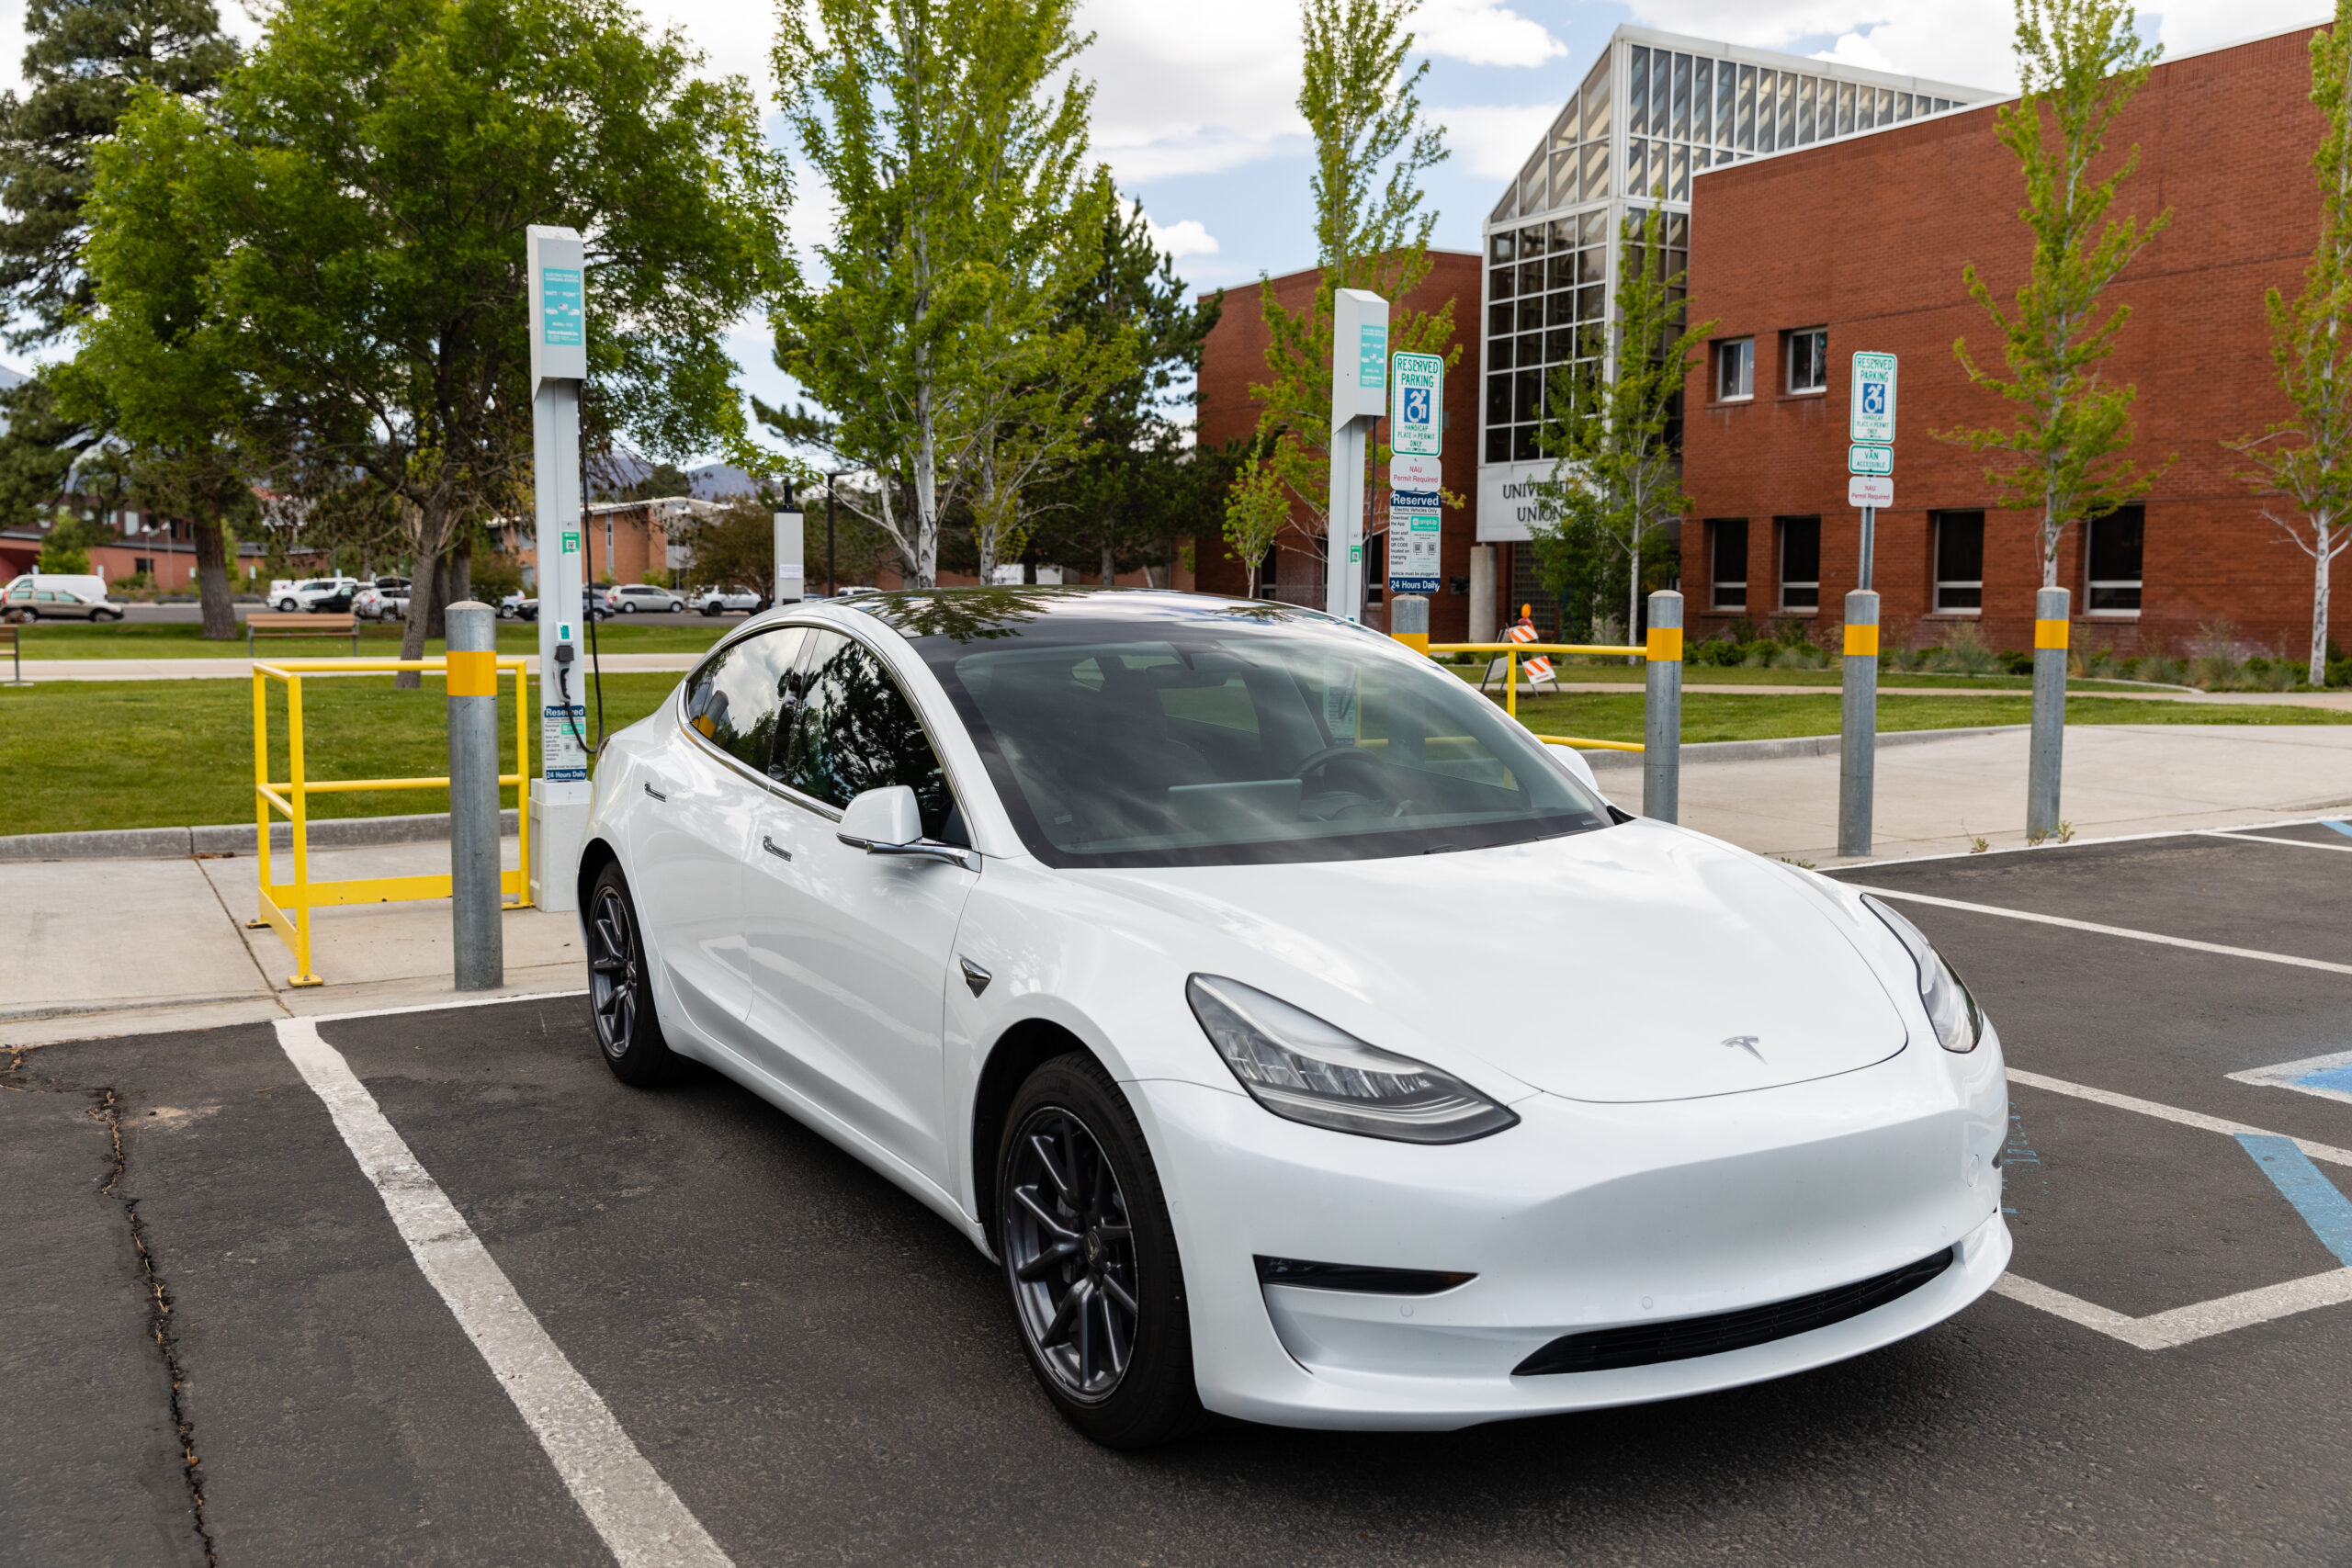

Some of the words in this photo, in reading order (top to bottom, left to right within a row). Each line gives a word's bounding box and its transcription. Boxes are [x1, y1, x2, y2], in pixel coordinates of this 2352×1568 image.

[1397, 358, 1438, 374] RESERVED
[1857, 357, 1892, 370] RESERVED
[1402, 373, 1434, 388] PARKING
[1860, 370, 1888, 383] PARKING
[1397, 431, 1412, 439] PLATE
[1865, 451, 1879, 459] VAN
[1413, 476, 1438, 484] Required
[1393, 494, 1439, 506] Reserved
[1517, 505, 1563, 522] UNION
[1423, 580, 1438, 590] Daily
